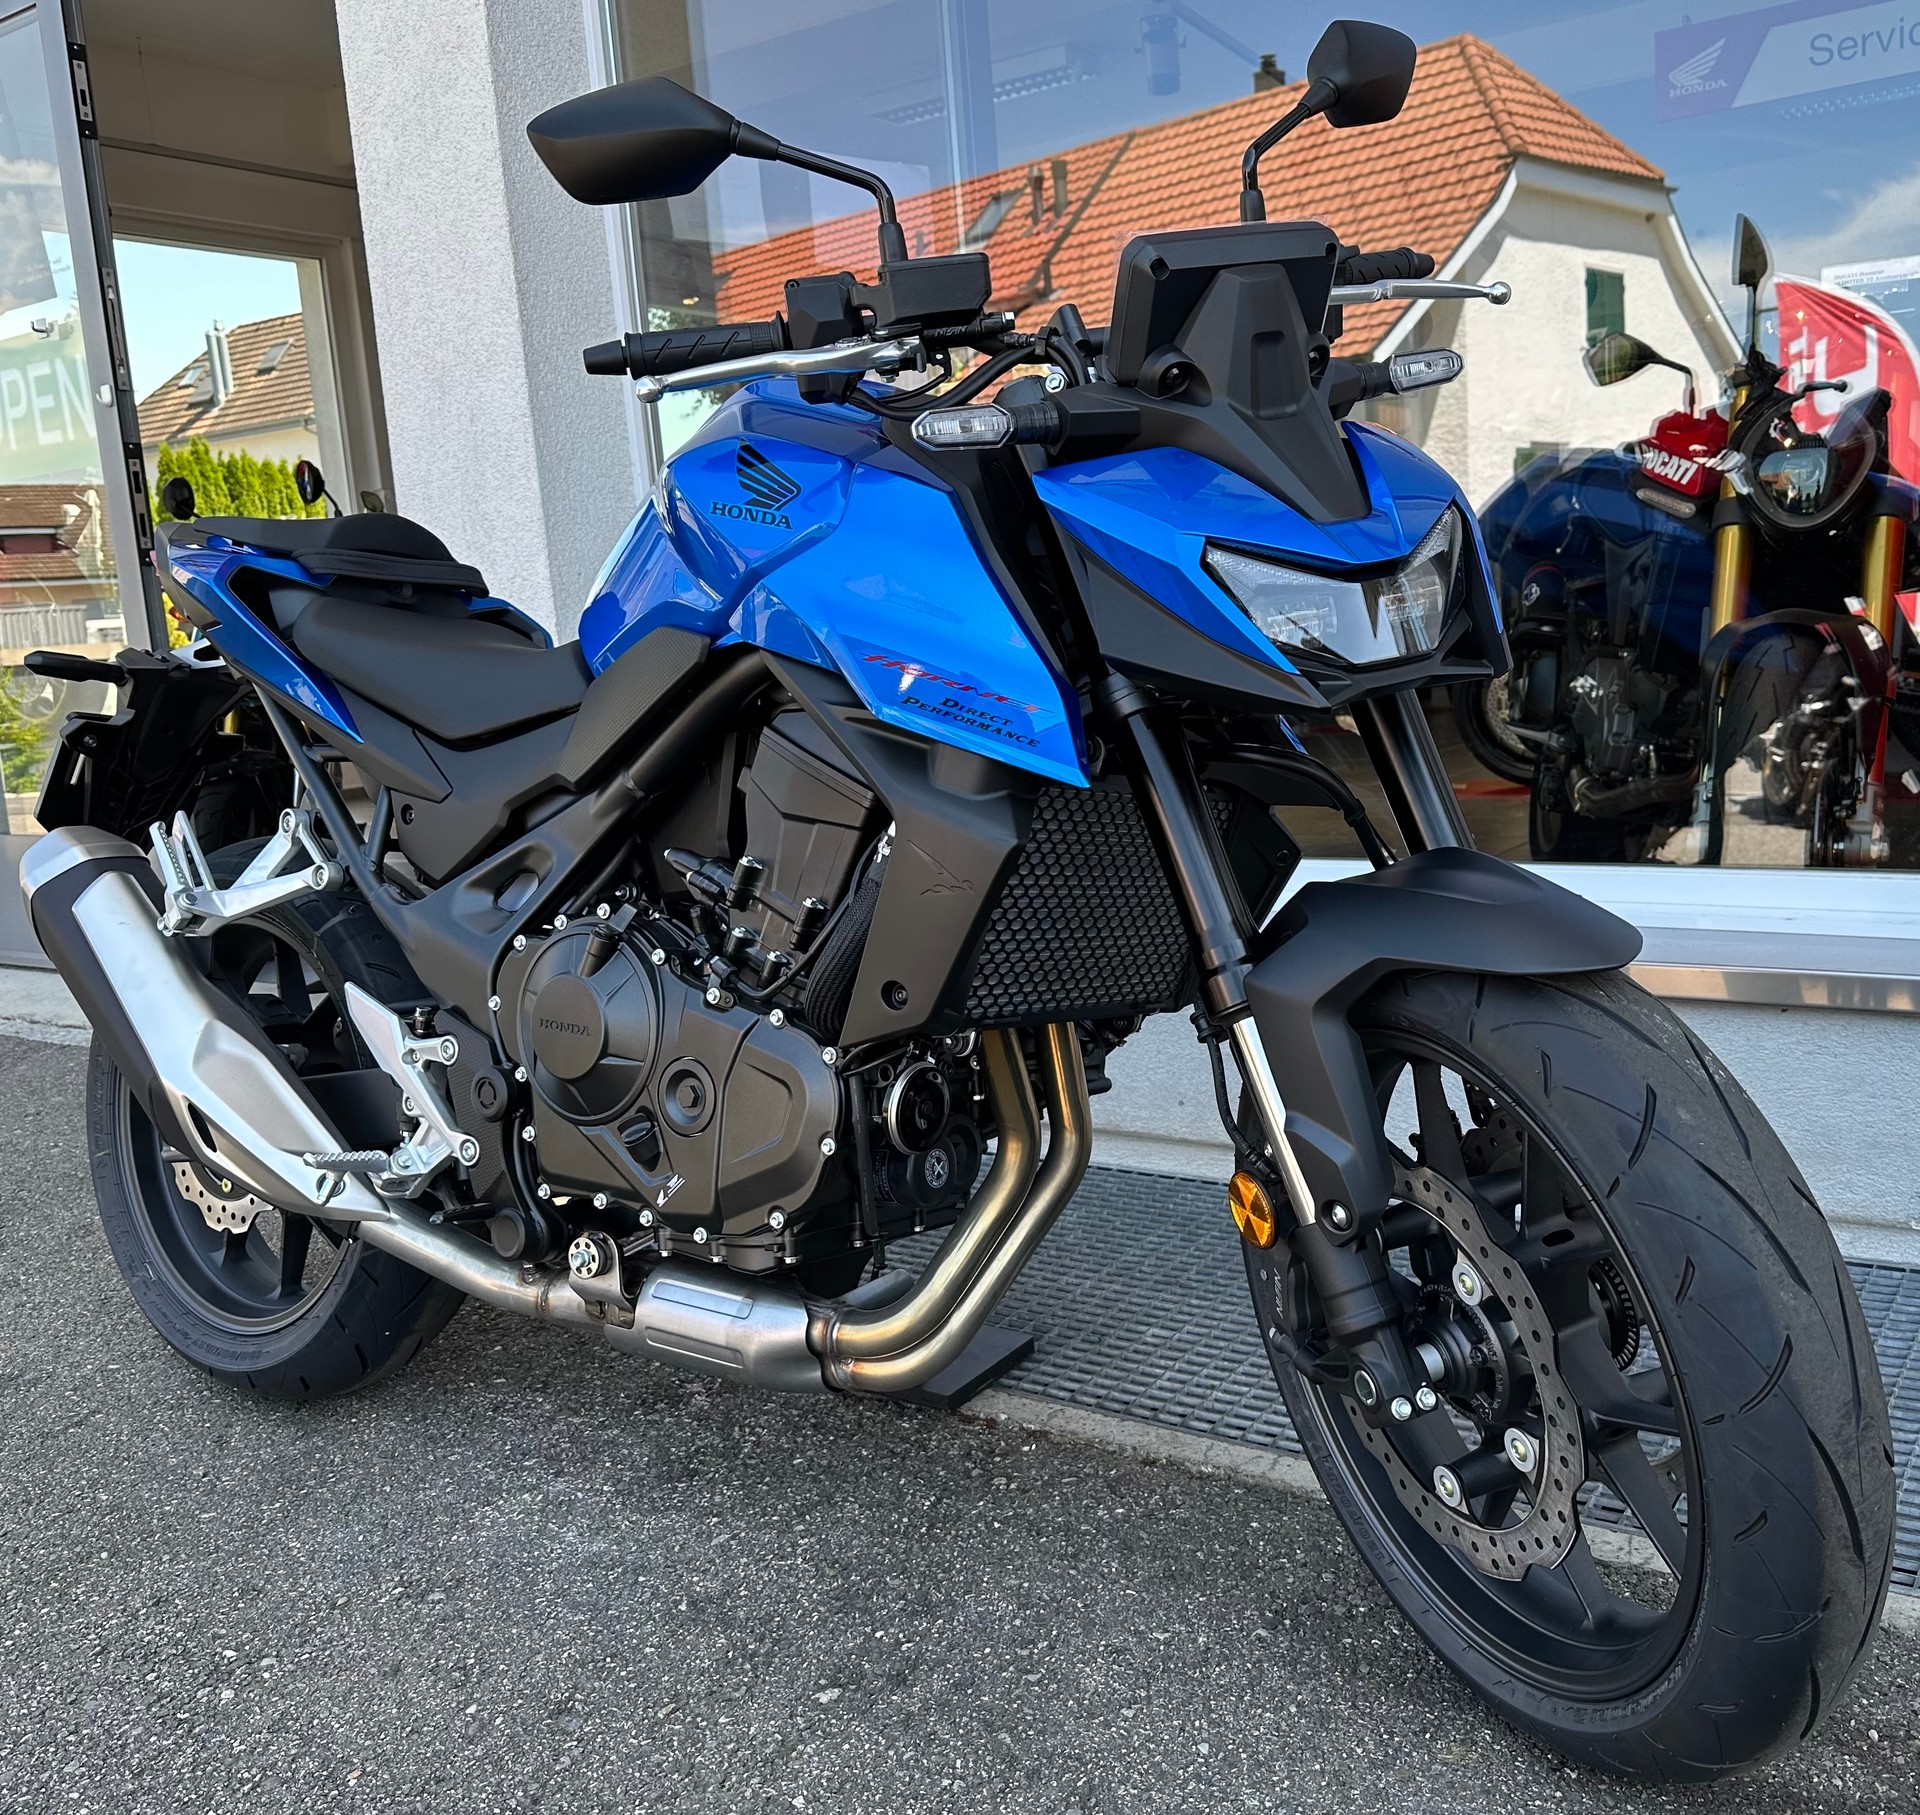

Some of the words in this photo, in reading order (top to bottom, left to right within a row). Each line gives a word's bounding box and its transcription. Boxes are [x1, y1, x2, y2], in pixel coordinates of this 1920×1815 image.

[1668, 79, 1728, 98] HONDA
[0, 353, 97, 451] PEN
[710, 501, 793, 530] HONDA
[539, 1018, 591, 1037] HONDA
